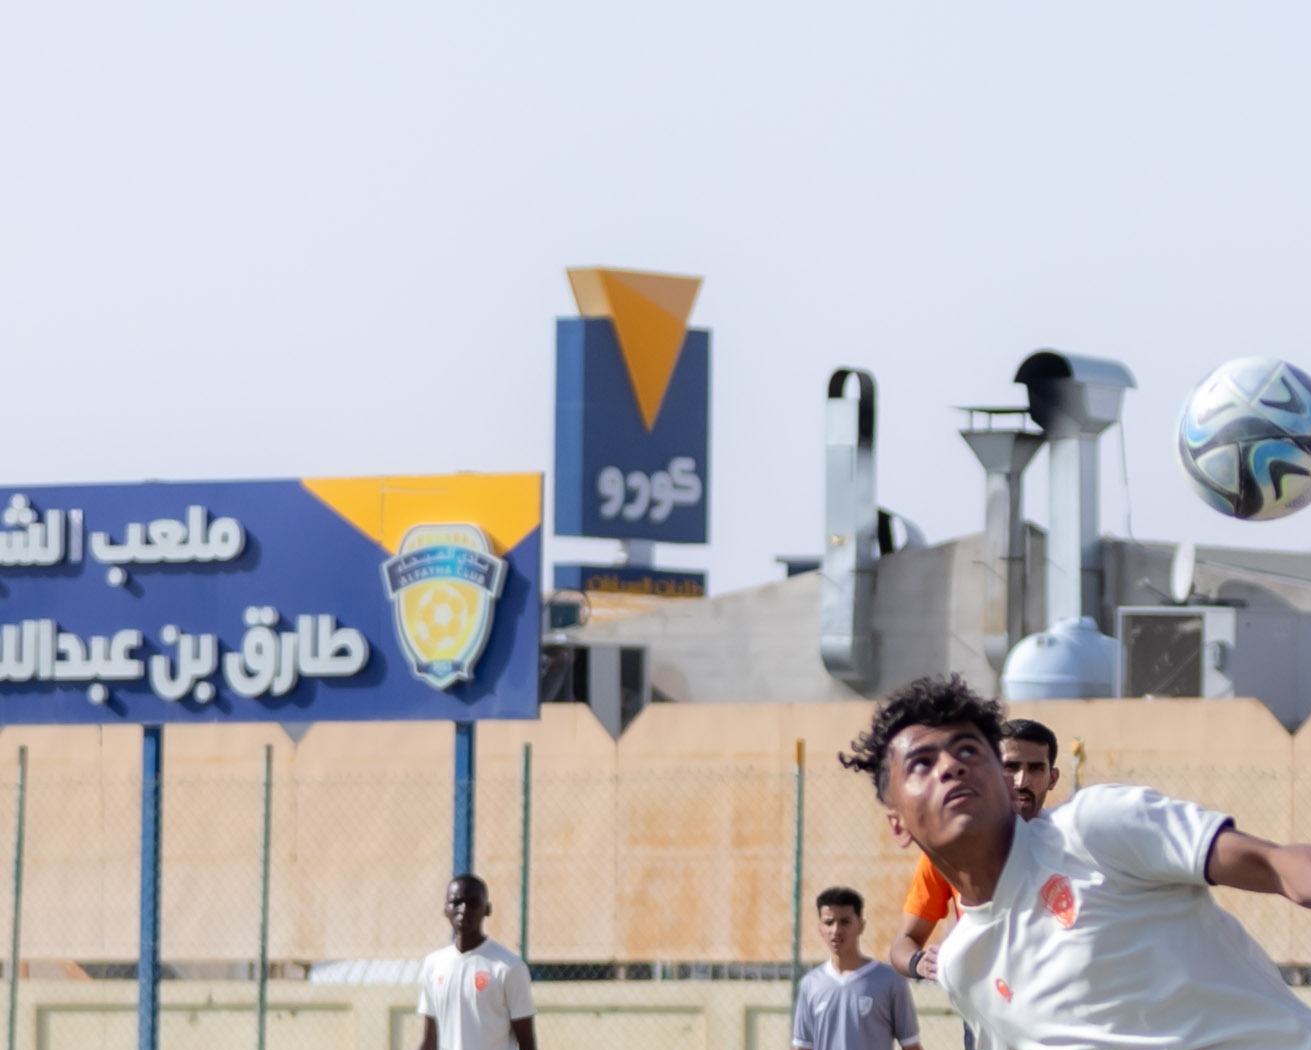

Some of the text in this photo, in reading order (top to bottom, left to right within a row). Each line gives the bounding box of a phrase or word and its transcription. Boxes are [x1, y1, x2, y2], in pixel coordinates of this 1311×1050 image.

[0, 493, 246, 588] ملعب الش
[456, 567, 486, 586] CLUB
[0, 606, 369, 705] طارق بن عبدالل
